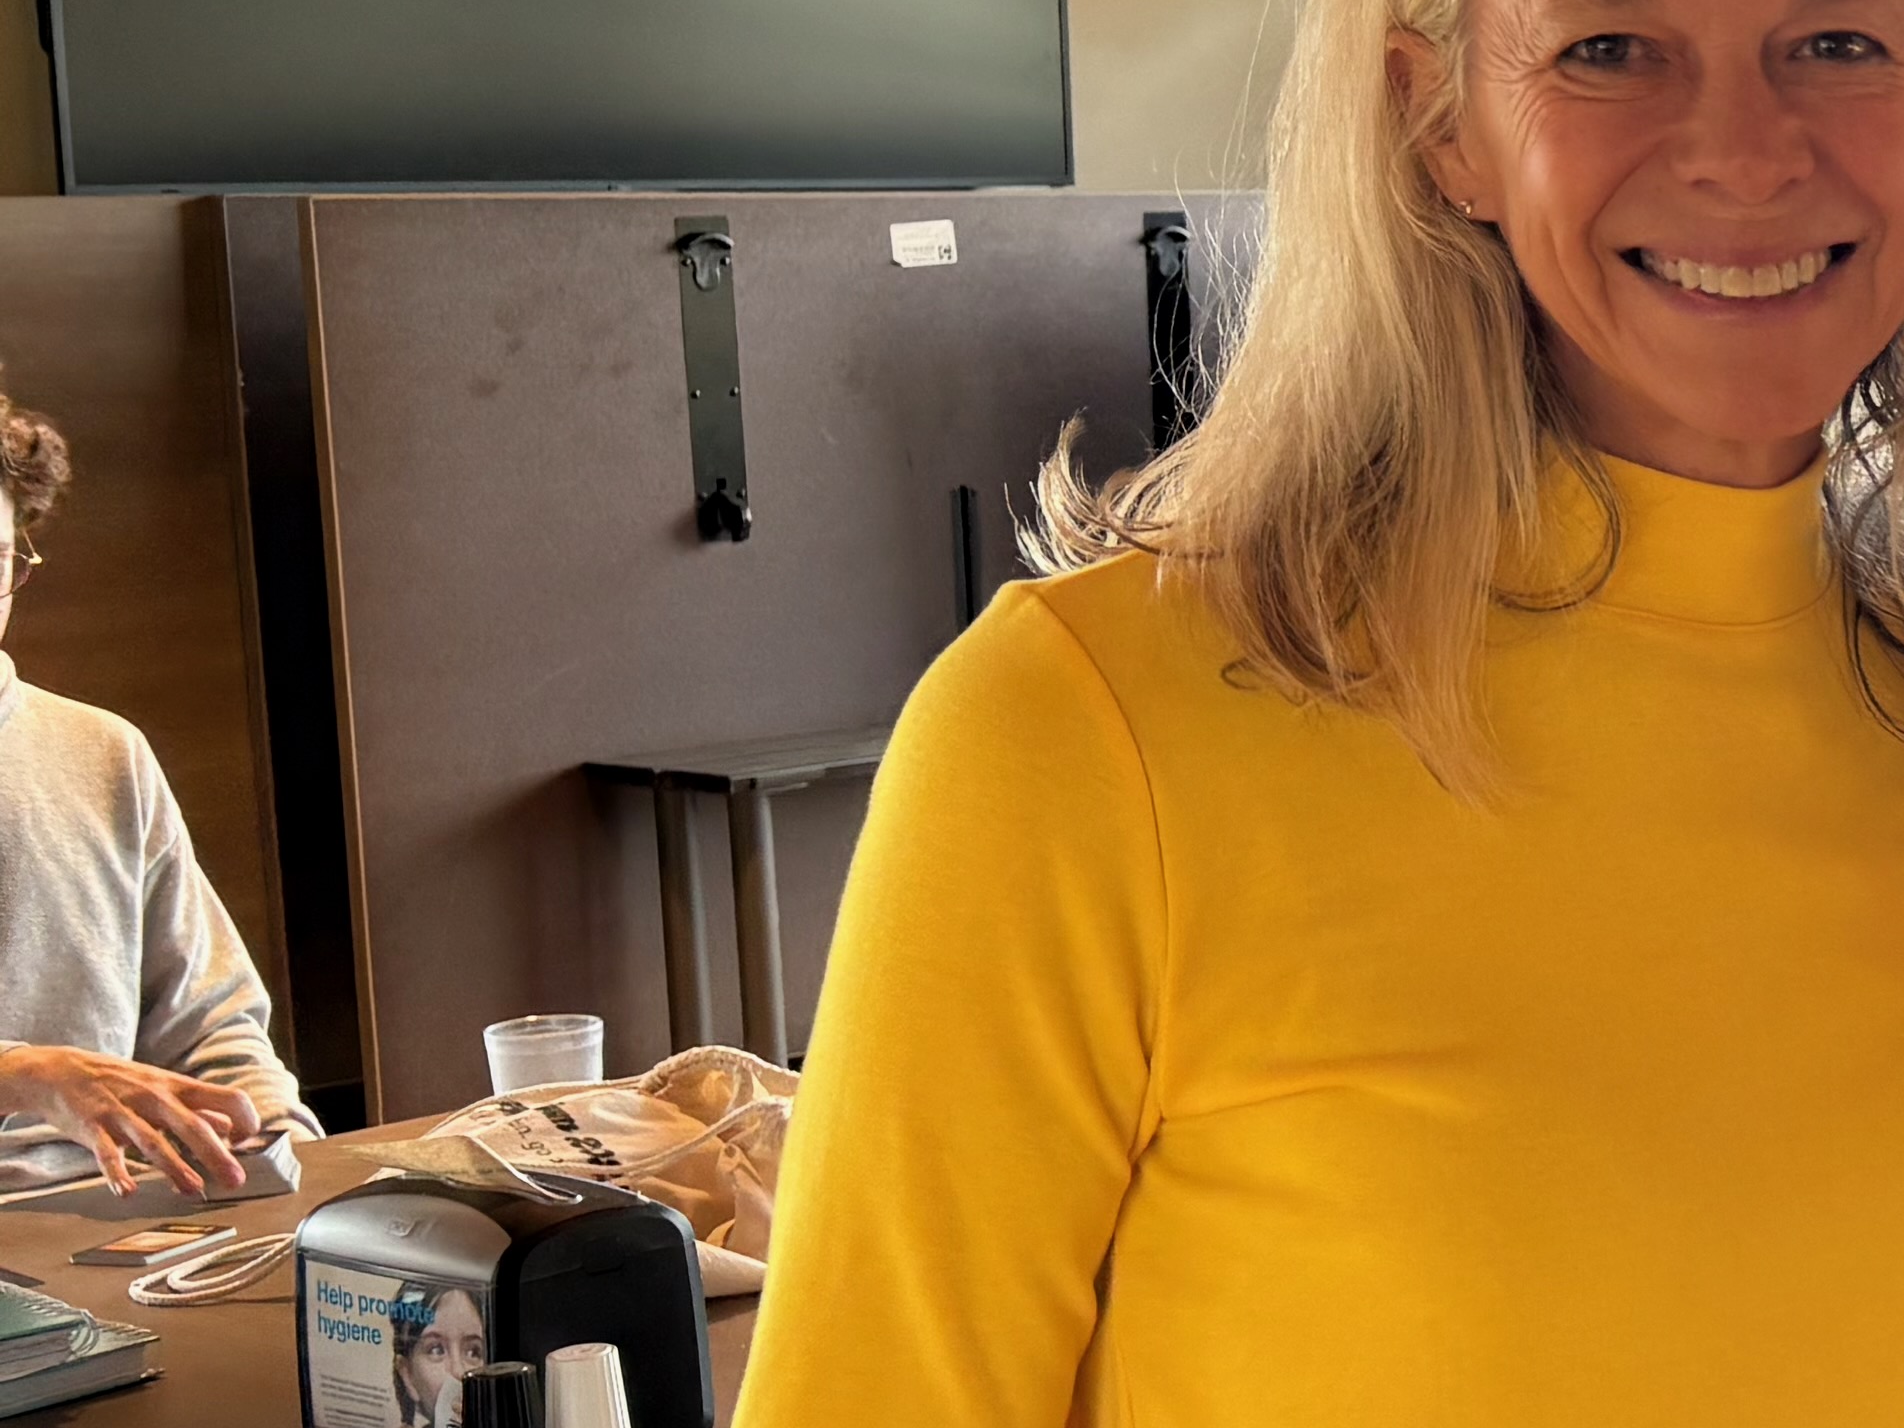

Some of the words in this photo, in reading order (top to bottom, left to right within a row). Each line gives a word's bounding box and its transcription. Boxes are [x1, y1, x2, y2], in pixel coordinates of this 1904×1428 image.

[317, 1280, 354, 1313] Help
[358, 1294, 435, 1323] promote
[317, 1310, 382, 1345] hygiene
